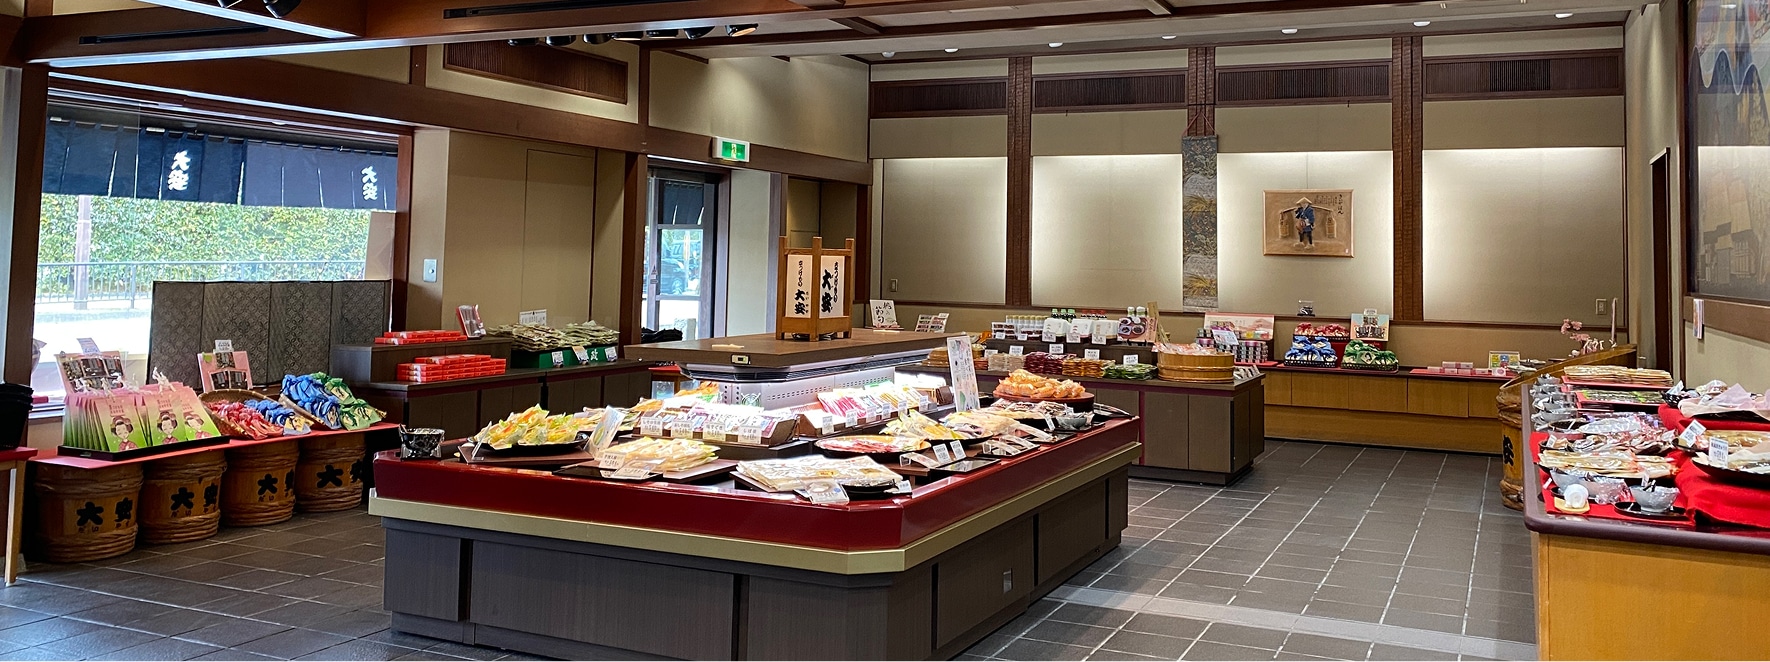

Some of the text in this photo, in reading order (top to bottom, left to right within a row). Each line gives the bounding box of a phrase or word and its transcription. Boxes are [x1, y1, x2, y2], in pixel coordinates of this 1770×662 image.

[794, 289, 805, 315] 大安
[821, 269, 832, 313] 大安
[76, 496, 133, 526] 大安
[170, 483, 218, 511] 大安
